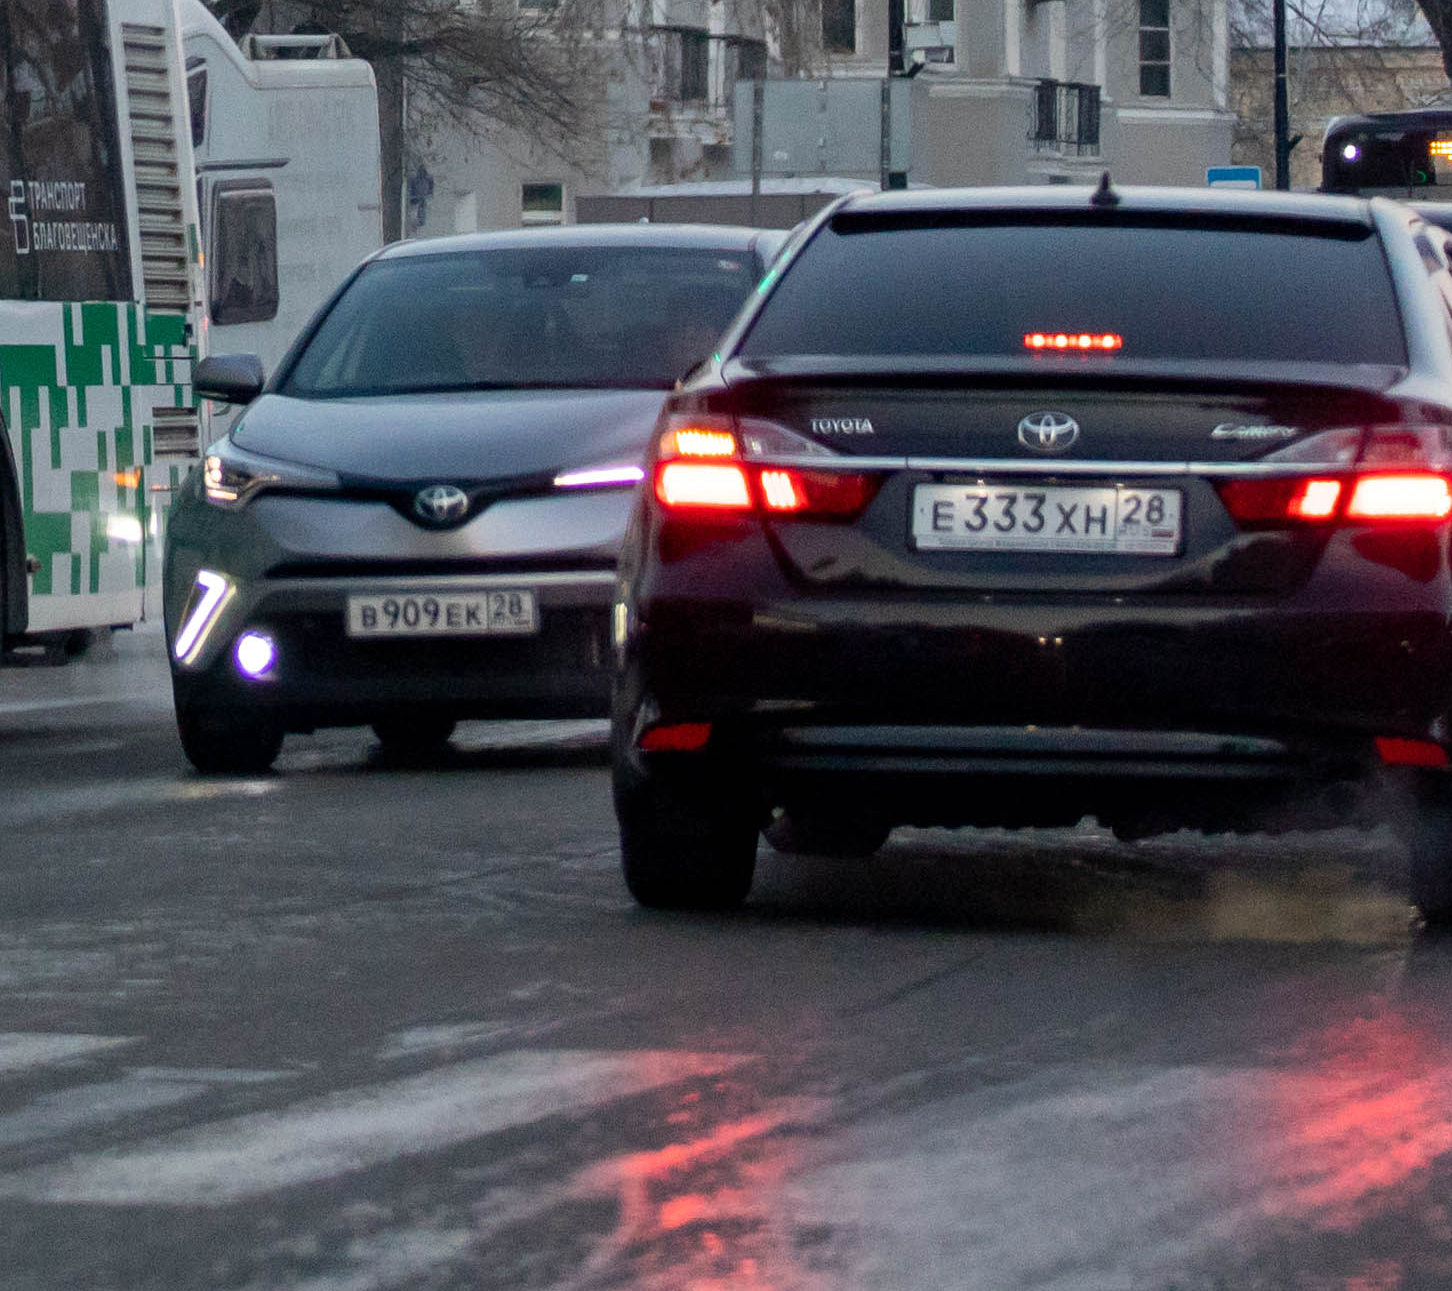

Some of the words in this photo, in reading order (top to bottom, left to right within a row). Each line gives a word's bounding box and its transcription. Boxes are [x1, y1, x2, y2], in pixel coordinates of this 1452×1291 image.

[27, 180, 87, 211] ТРАНСПОРТ
[32, 221, 118, 256] БЛАГОВЕЩЕНСКА
[810, 418, 875, 434] TOYOTA
[1122, 494, 1165, 524] 28
